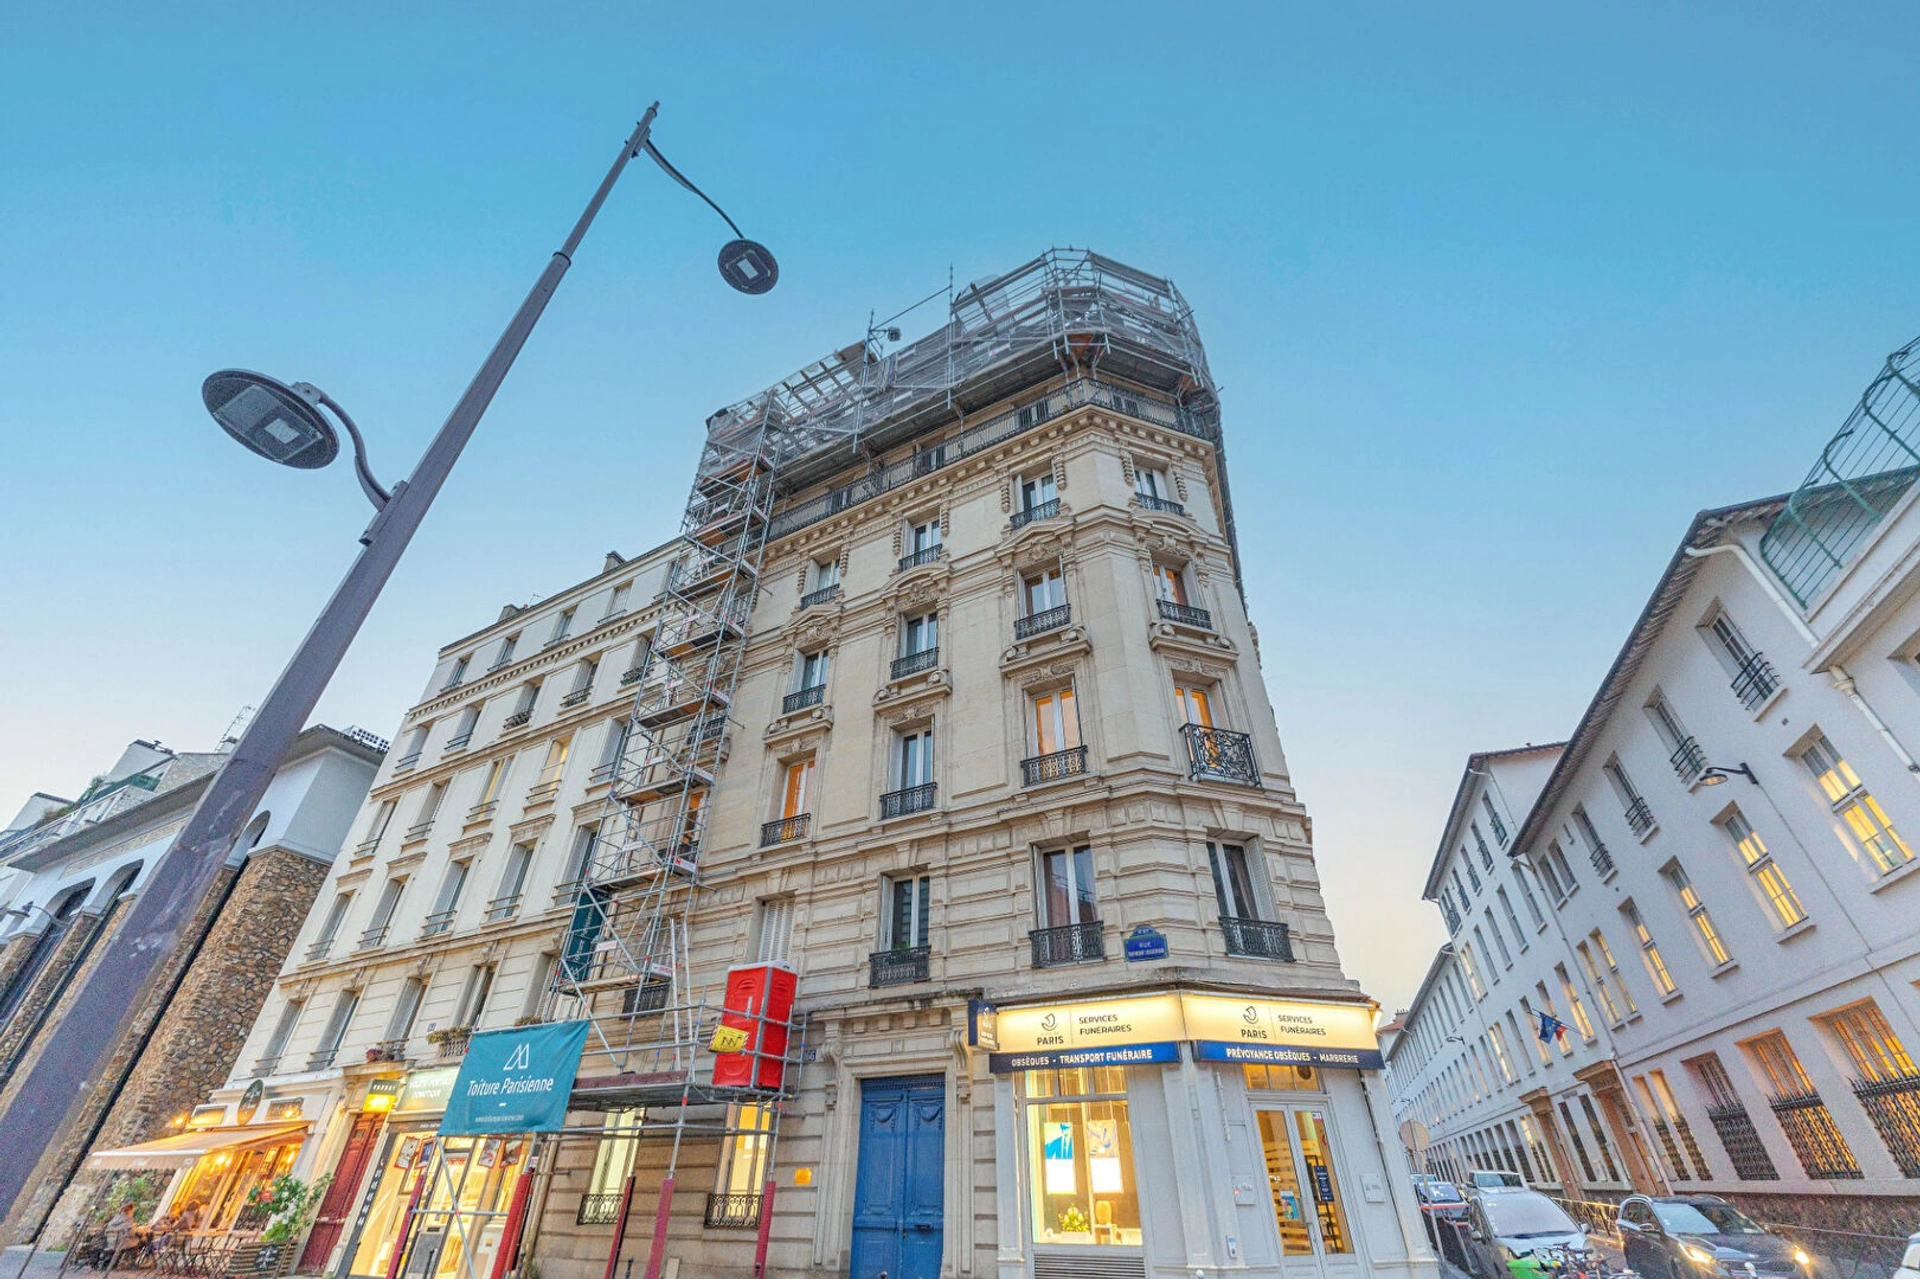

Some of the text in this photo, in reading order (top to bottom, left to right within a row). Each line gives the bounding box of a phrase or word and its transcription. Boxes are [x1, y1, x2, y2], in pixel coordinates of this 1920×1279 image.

[1079, 1014, 1118, 1025] SERVICES
[1278, 1014, 1313, 1024] SERVICES
[1080, 1024, 1132, 1035] FUNÉRAIRES
[1241, 1028, 1267, 1039] PARIS
[1280, 1025, 1326, 1036] FUNÉRAIRES
[1037, 1035, 1064, 1046] PARIS
[1011, 1055, 1049, 1067] OBSÈQUES
[1060, 1052, 1104, 1064] TRANSPORT
[1106, 1048, 1152, 1061] FUNÉRAIRE
[1226, 1046, 1274, 1060] PRÉVOYANCE
[1274, 1049, 1311, 1062] OBSÈQUES
[1319, 1053, 1359, 1064] MARBRERIE
[467, 1078, 500, 1097] Toiture
[500, 1075, 554, 1095] Parisienne
